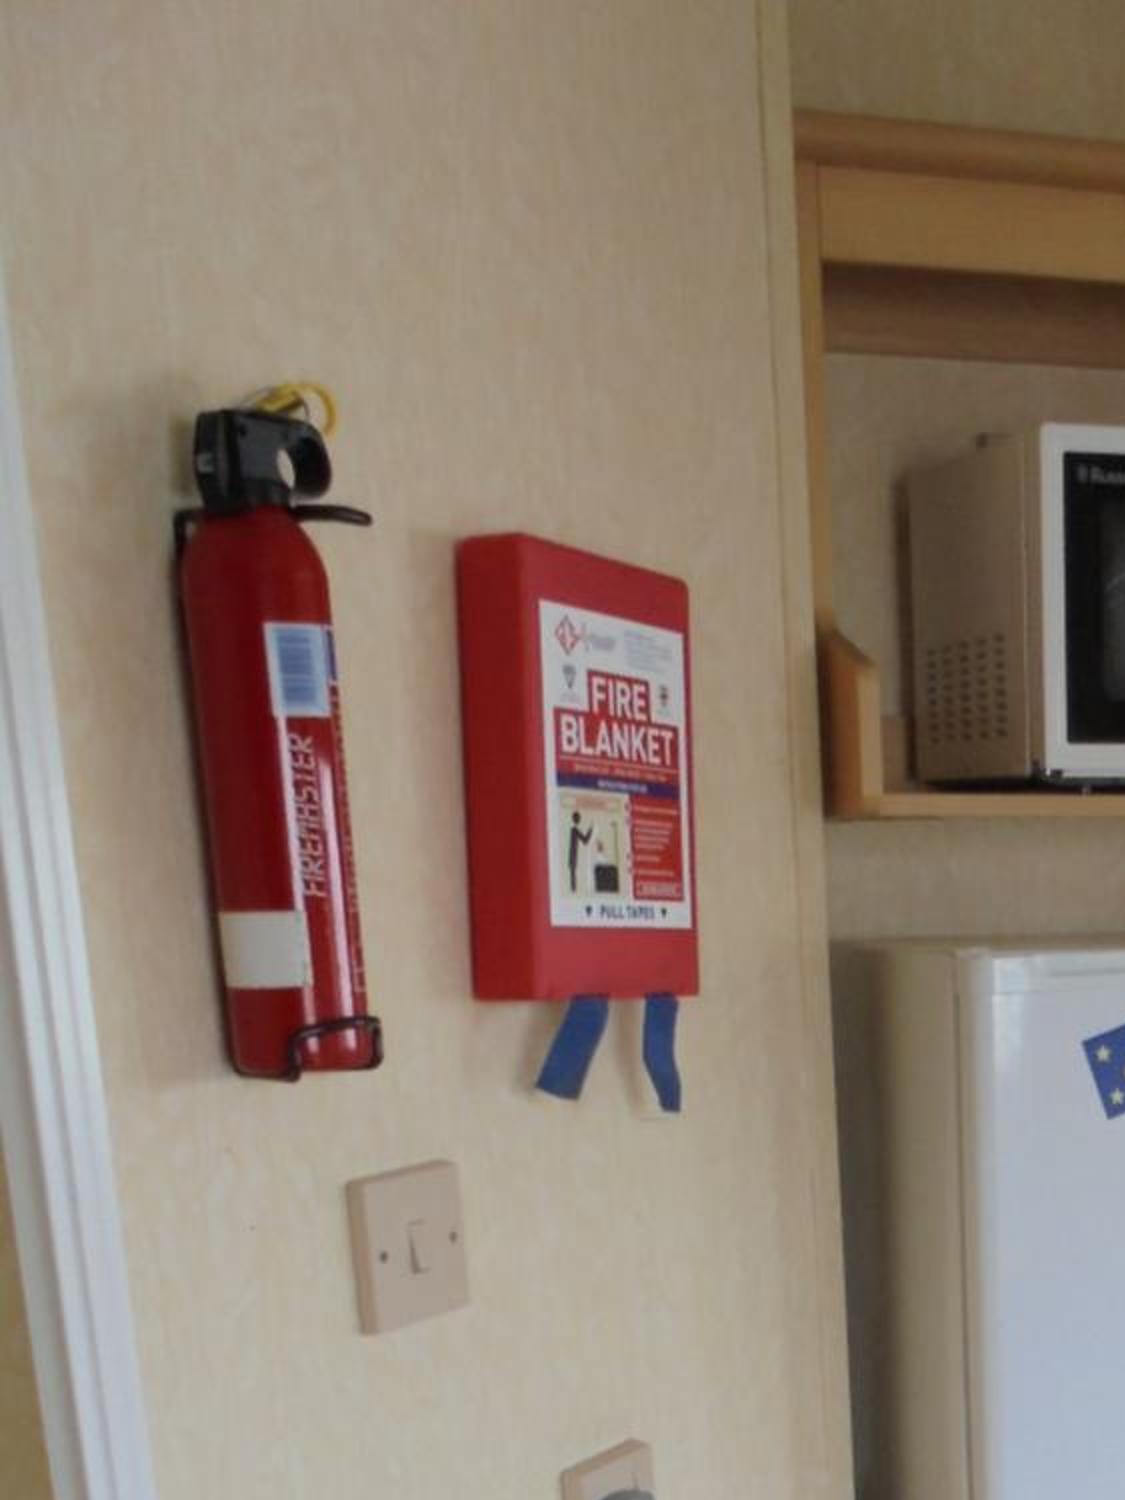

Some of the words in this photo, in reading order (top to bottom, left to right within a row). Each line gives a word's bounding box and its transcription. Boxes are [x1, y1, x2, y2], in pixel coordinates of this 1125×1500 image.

[591, 676, 648, 721] FIRE
[560, 713, 674, 767] BLANKET
[289, 732, 327, 898] FIREMASTER
[600, 905, 625, 920] PULL
